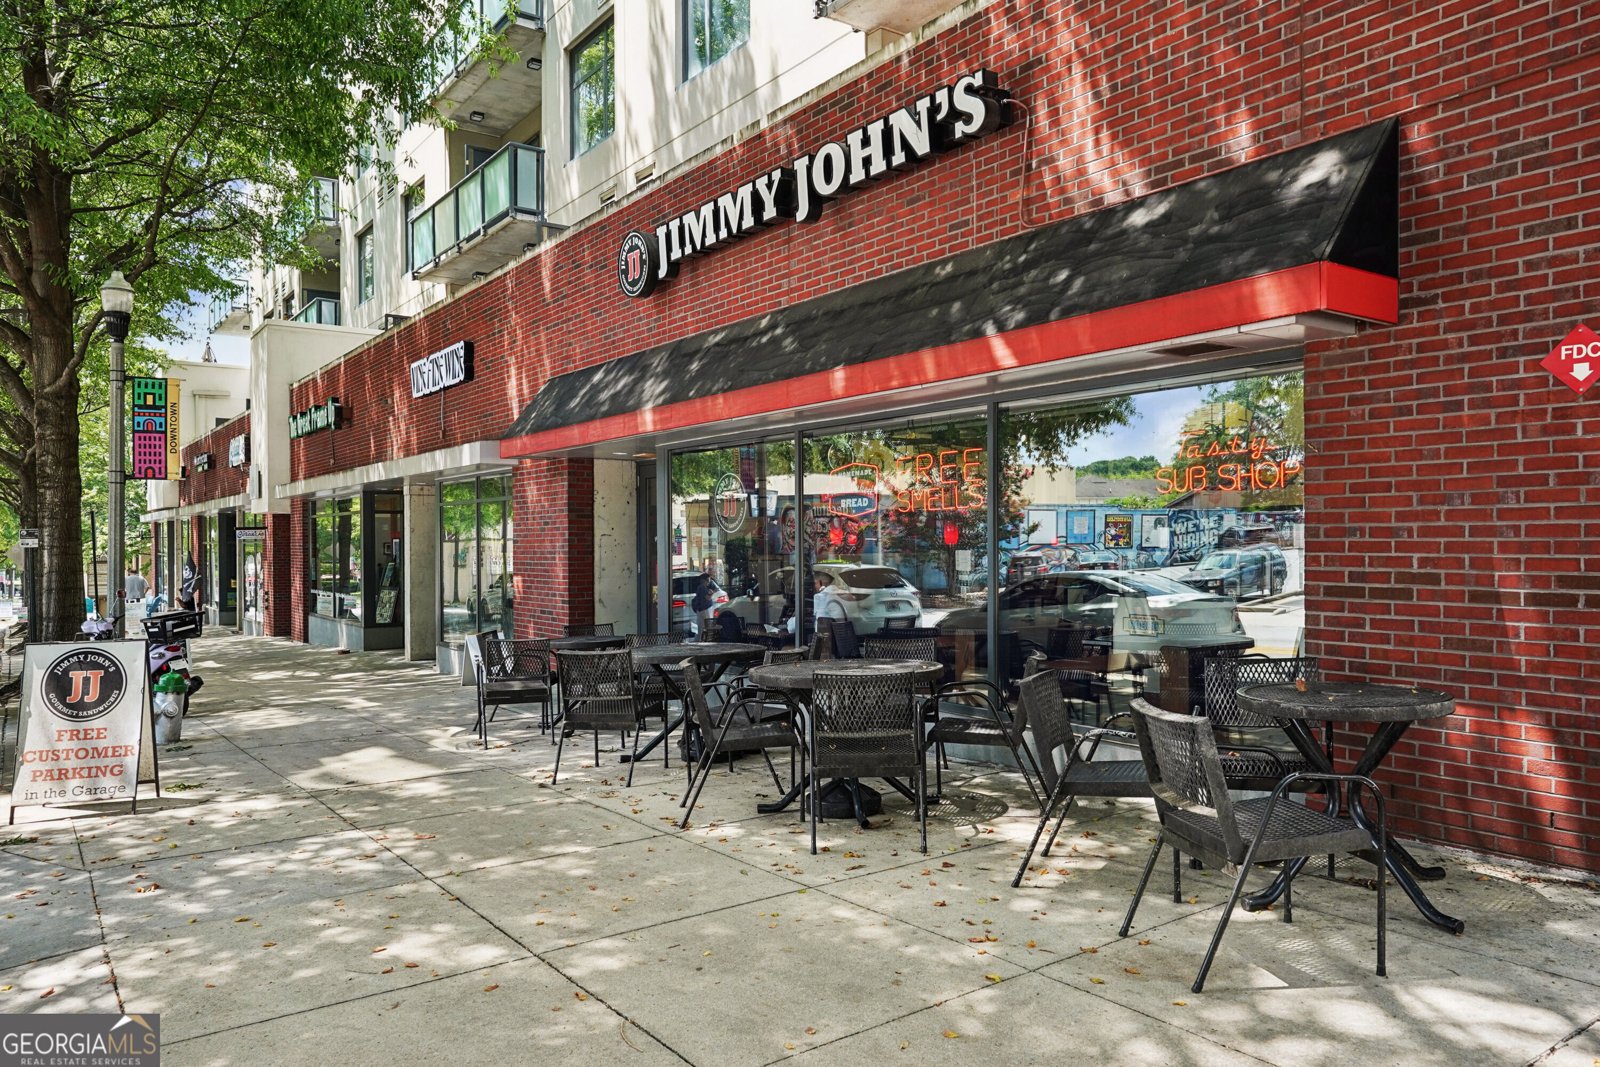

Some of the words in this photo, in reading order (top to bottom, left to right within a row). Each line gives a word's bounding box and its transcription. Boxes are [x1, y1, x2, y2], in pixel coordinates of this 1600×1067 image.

[656, 168, 781, 279] JIMMY
[793, 70, 986, 222] JOHN'S
[627, 249, 640, 281] JJ
[1561, 341, 1600, 360] FDC
[169, 401, 178, 454] DOWNTOWN
[1178, 429, 1280, 460] Tasty
[896, 447, 984, 485] FREE
[1156, 464, 1207, 494] SUB
[1217, 460, 1301, 494] SHOP
[840, 497, 869, 508] BREAD
[897, 483, 985, 513] SMELLS
[54, 654, 85, 675] JIMMY
[87, 654, 116, 672] JOHN'S
[66, 670, 104, 703] JJ
[49, 693, 78, 716] GOURMET
[78, 690, 119, 716] SANDWICHES
[55, 727, 107, 742] FREE
[22, 745, 135, 763] CUSTOMER
[31, 763, 124, 782] PARKING
[24, 789, 38, 800] in
[44, 788, 67, 799] the
[71, 784, 127, 797] Garage
